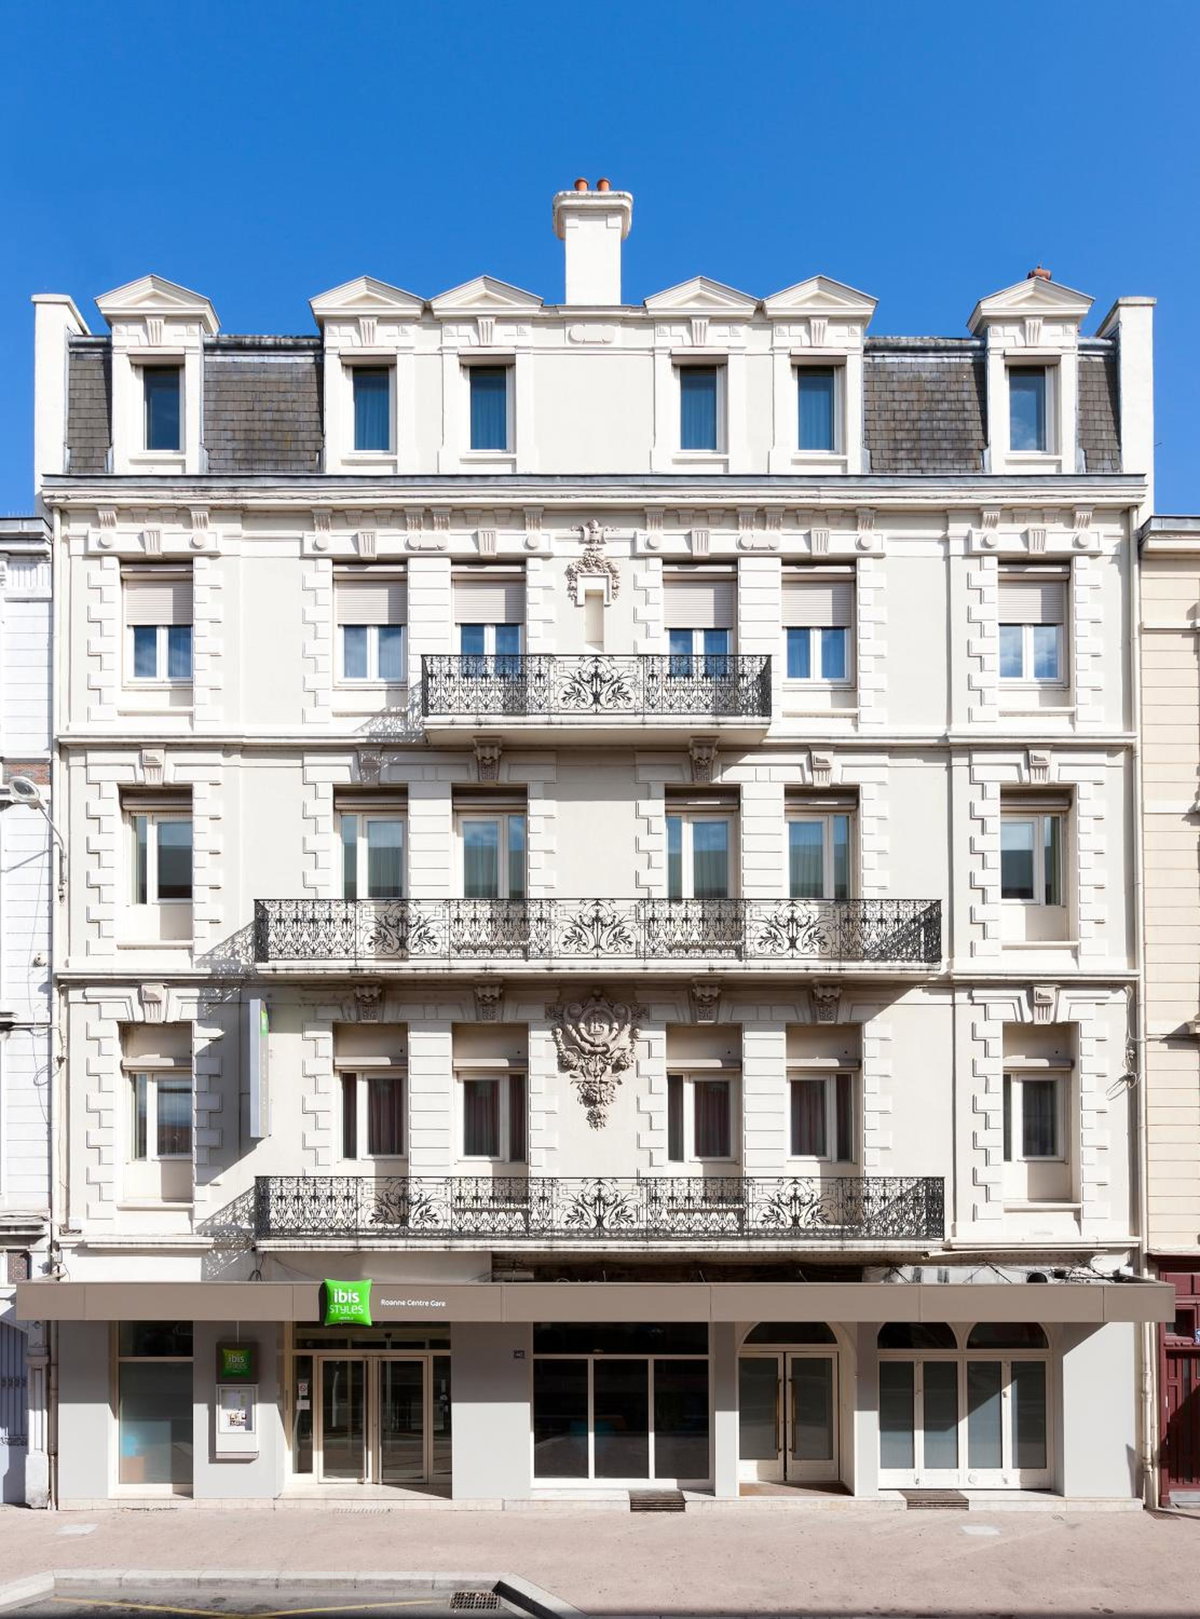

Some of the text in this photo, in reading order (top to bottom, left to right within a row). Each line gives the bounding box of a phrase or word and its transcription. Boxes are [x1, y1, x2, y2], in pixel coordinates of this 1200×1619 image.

[334, 1288, 360, 1303] ibis
[380, 1298, 446, 1307] Roanne Centre Gare
